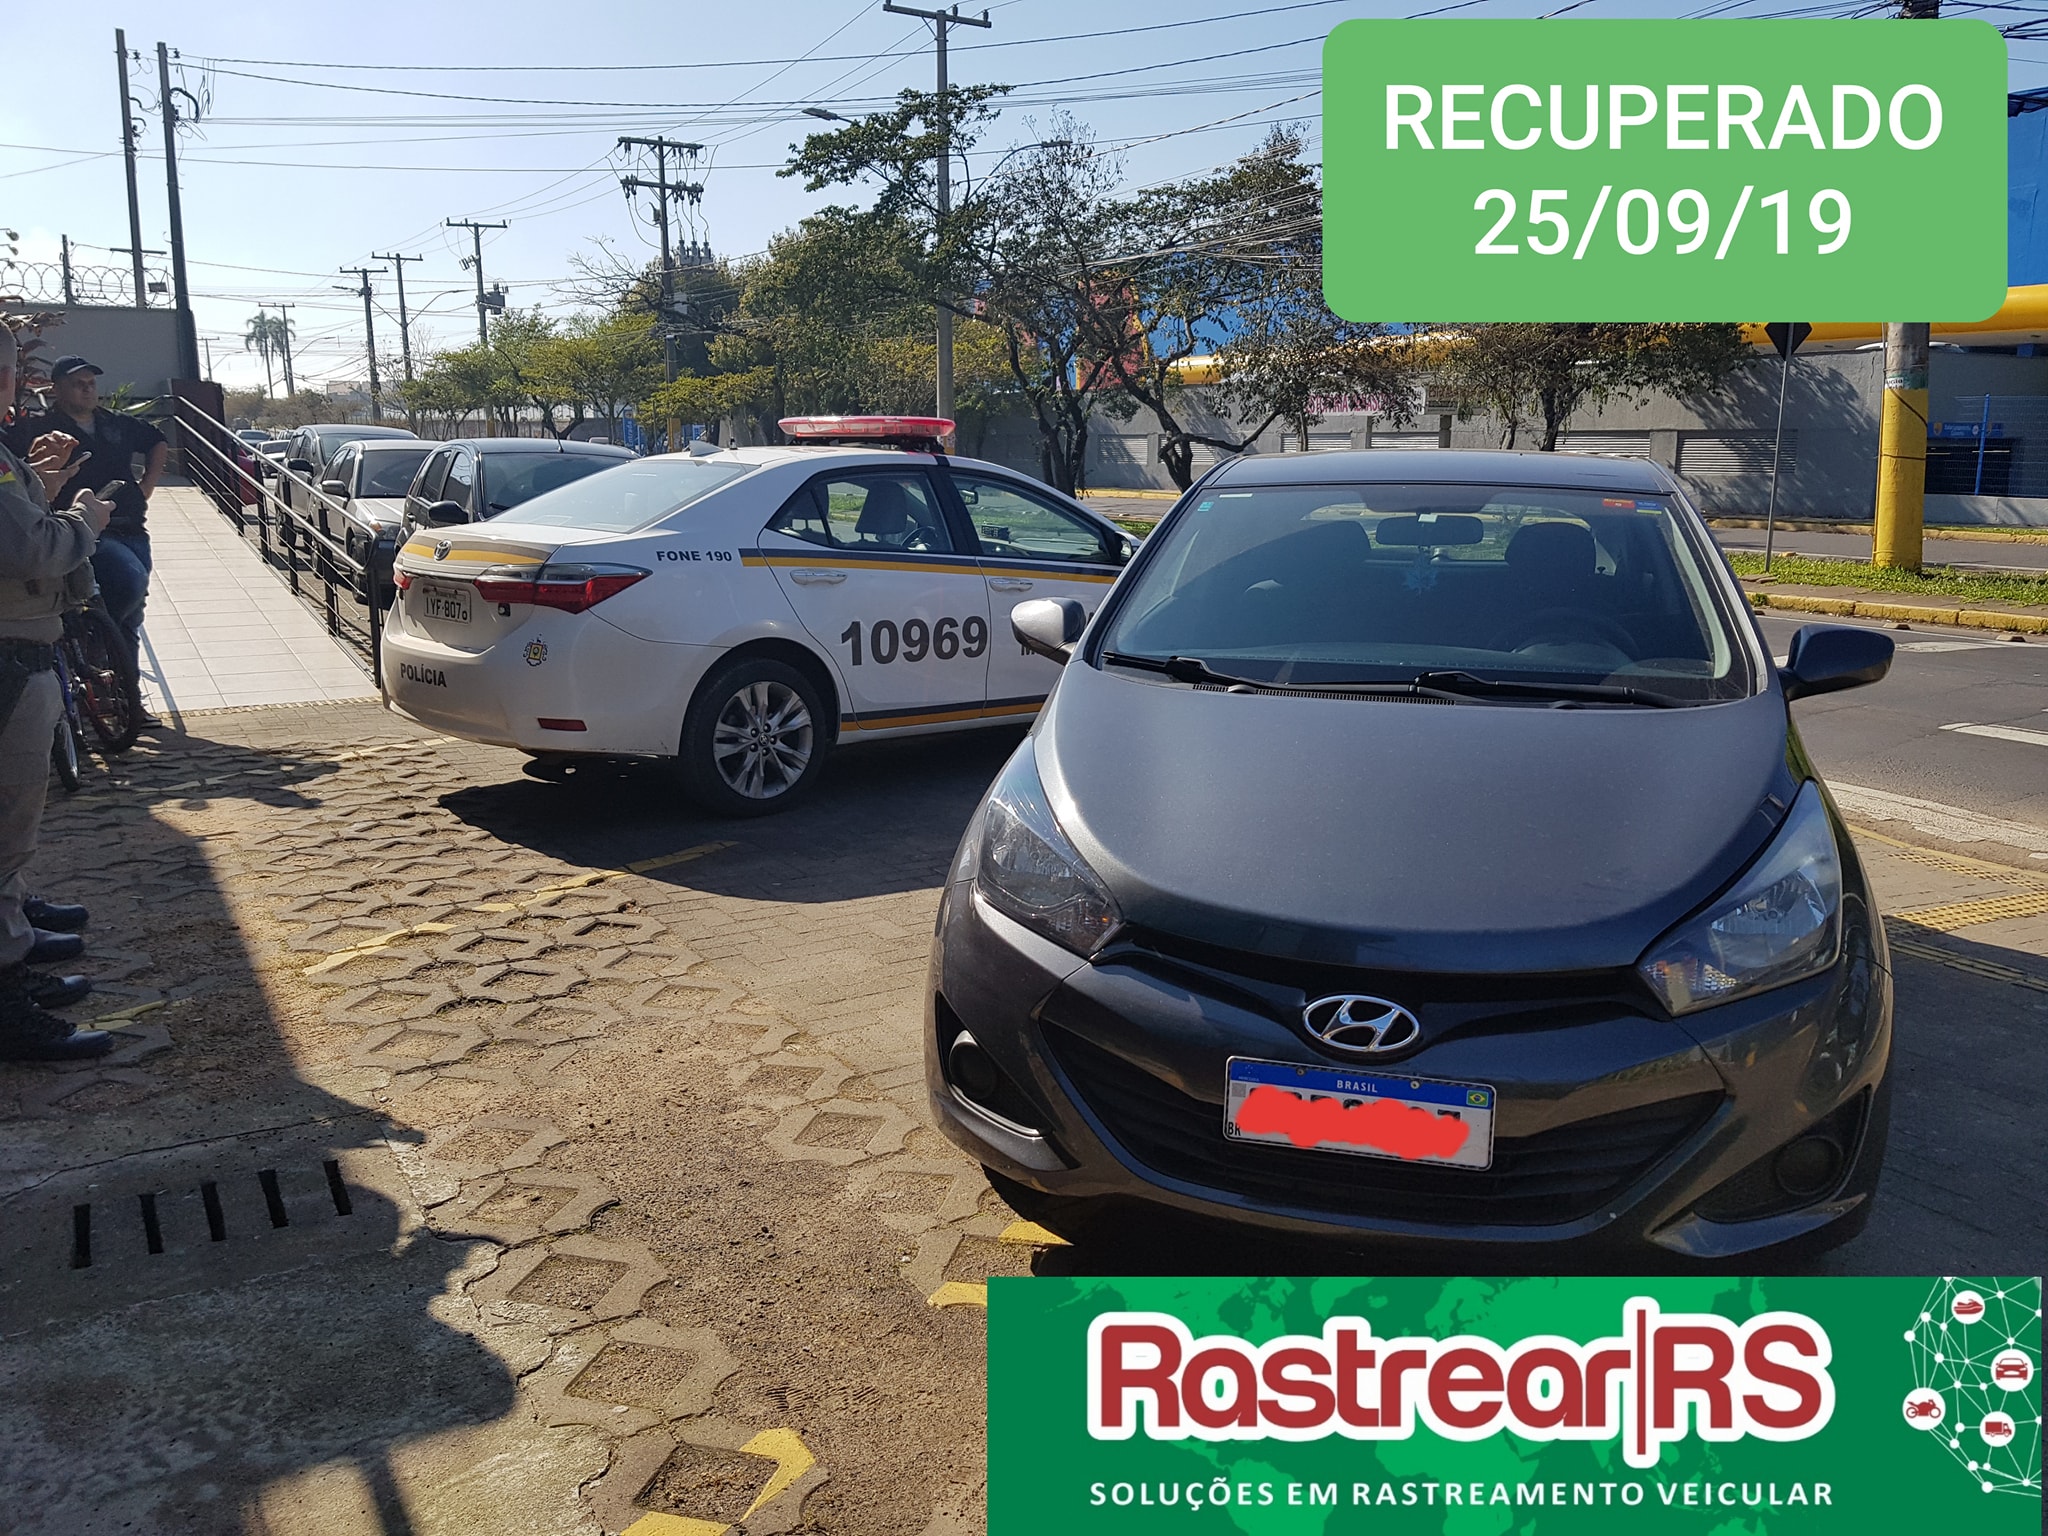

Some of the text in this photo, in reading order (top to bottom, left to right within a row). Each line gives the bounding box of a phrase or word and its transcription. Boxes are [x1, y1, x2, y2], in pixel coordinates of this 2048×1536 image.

[656, 550, 732, 562] FONE 190
[841, 616, 988, 667] 10969
[400, 662, 448, 688] POLÍCIA
[1336, 1079, 1378, 1094] BRASIL
